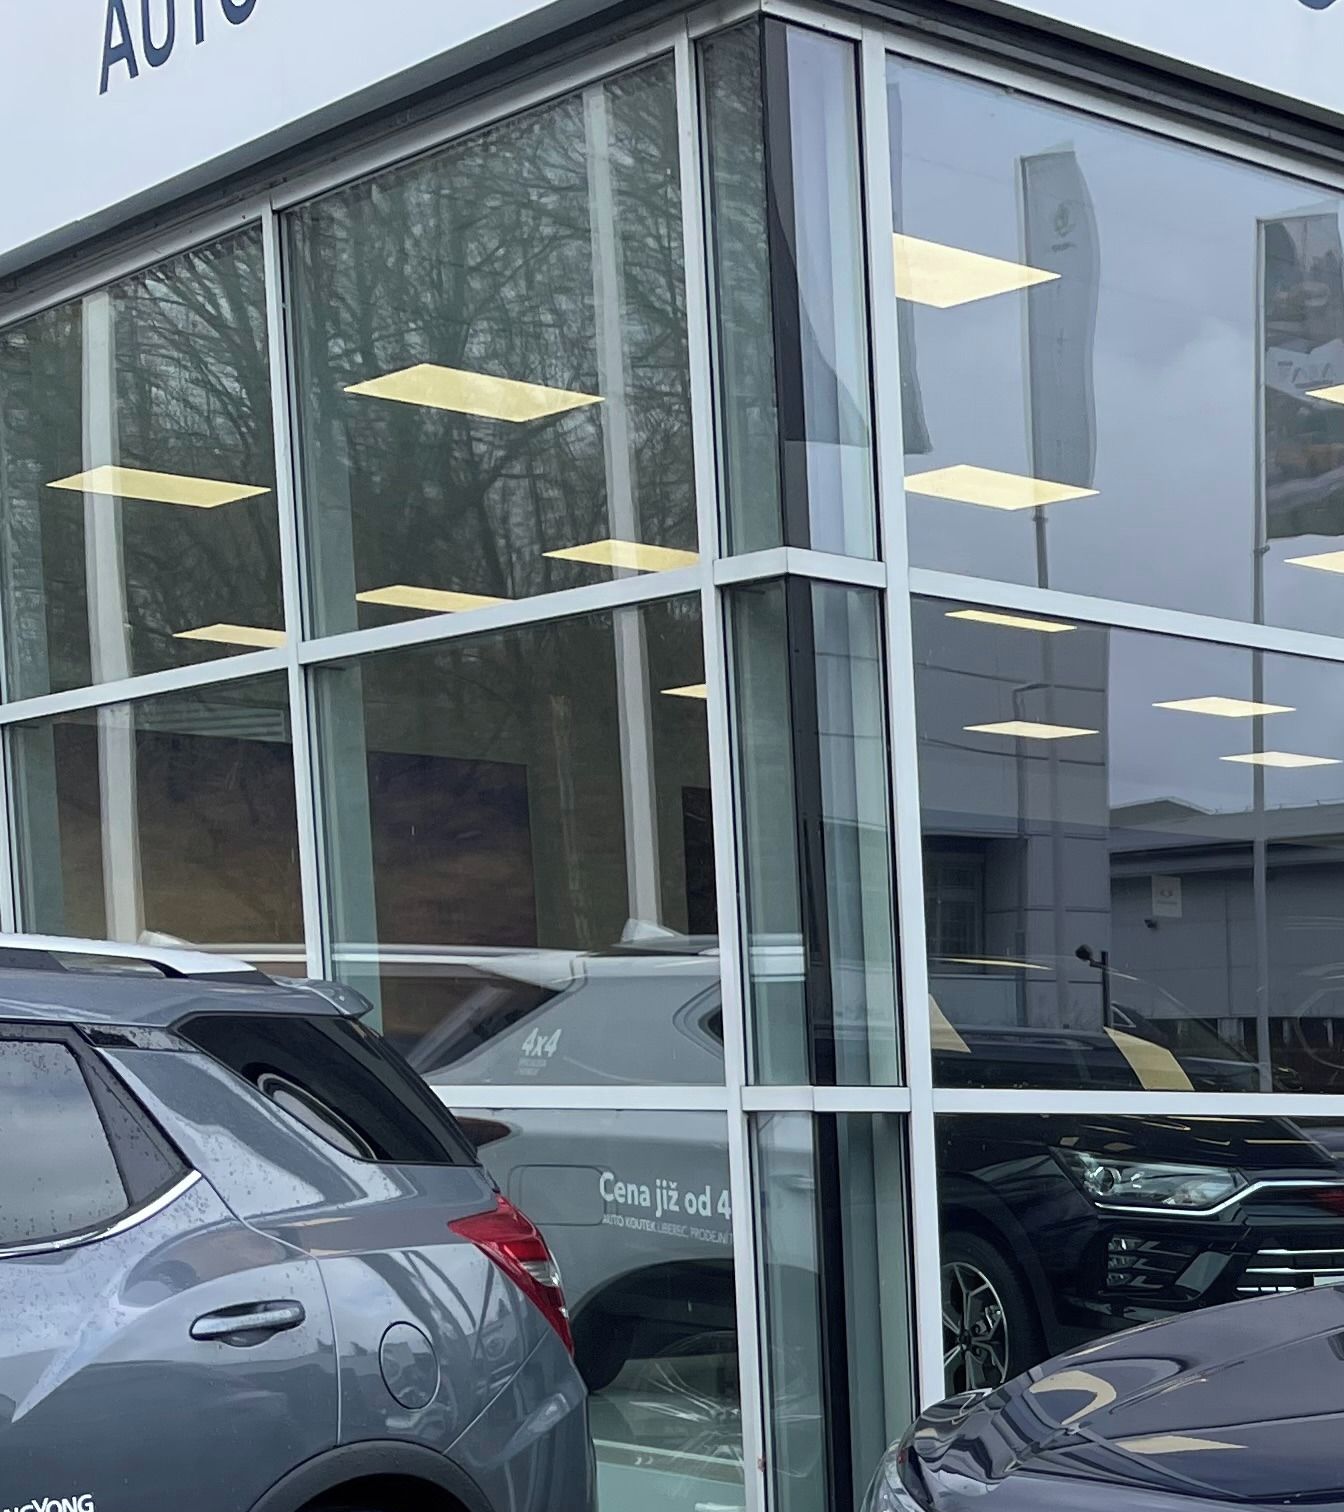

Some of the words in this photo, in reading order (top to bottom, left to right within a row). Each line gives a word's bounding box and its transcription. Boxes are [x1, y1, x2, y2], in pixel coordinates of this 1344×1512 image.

[521, 1027, 562, 1057] 4x4
[600, 1171, 651, 1207] Cena
[655, 1178, 680, 1218] již
[684, 1185, 712, 1217] od
